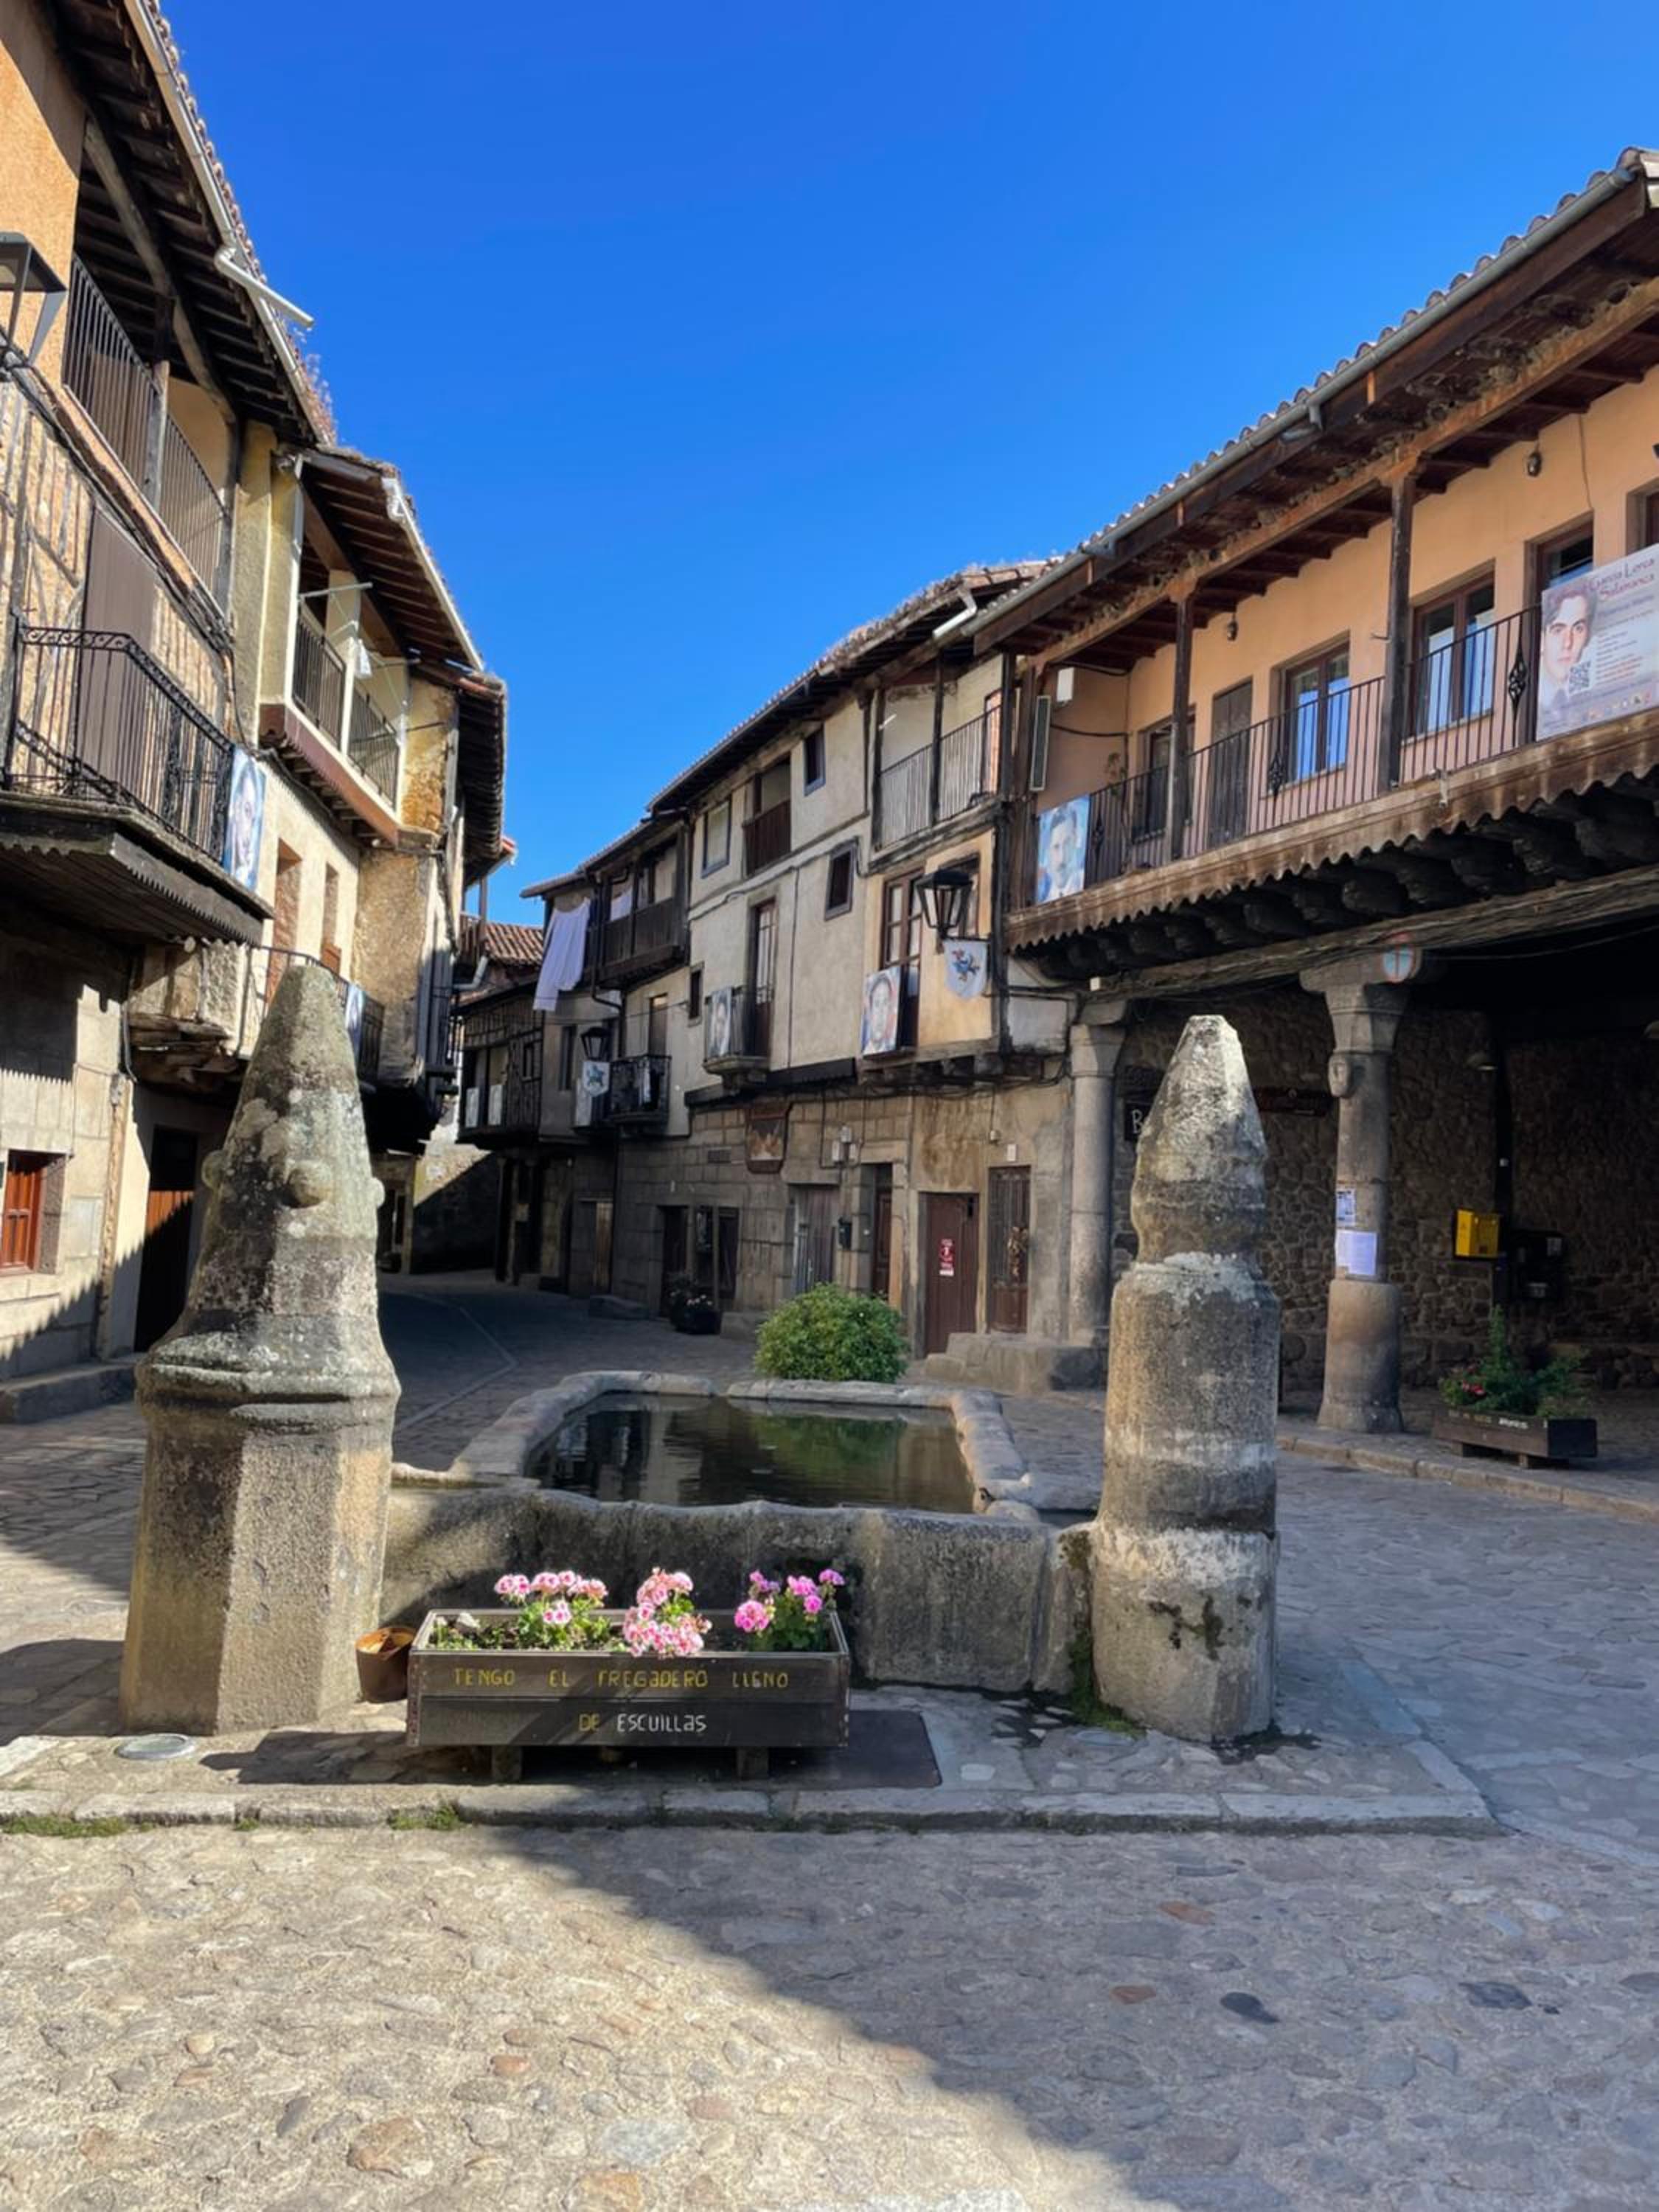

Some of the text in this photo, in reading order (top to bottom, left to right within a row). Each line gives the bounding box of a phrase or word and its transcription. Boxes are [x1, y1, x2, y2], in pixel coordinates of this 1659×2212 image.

[454, 1669, 515, 1686] TENGO
[549, 1669, 569, 1687] EL
[579, 1713, 600, 1731] DE
